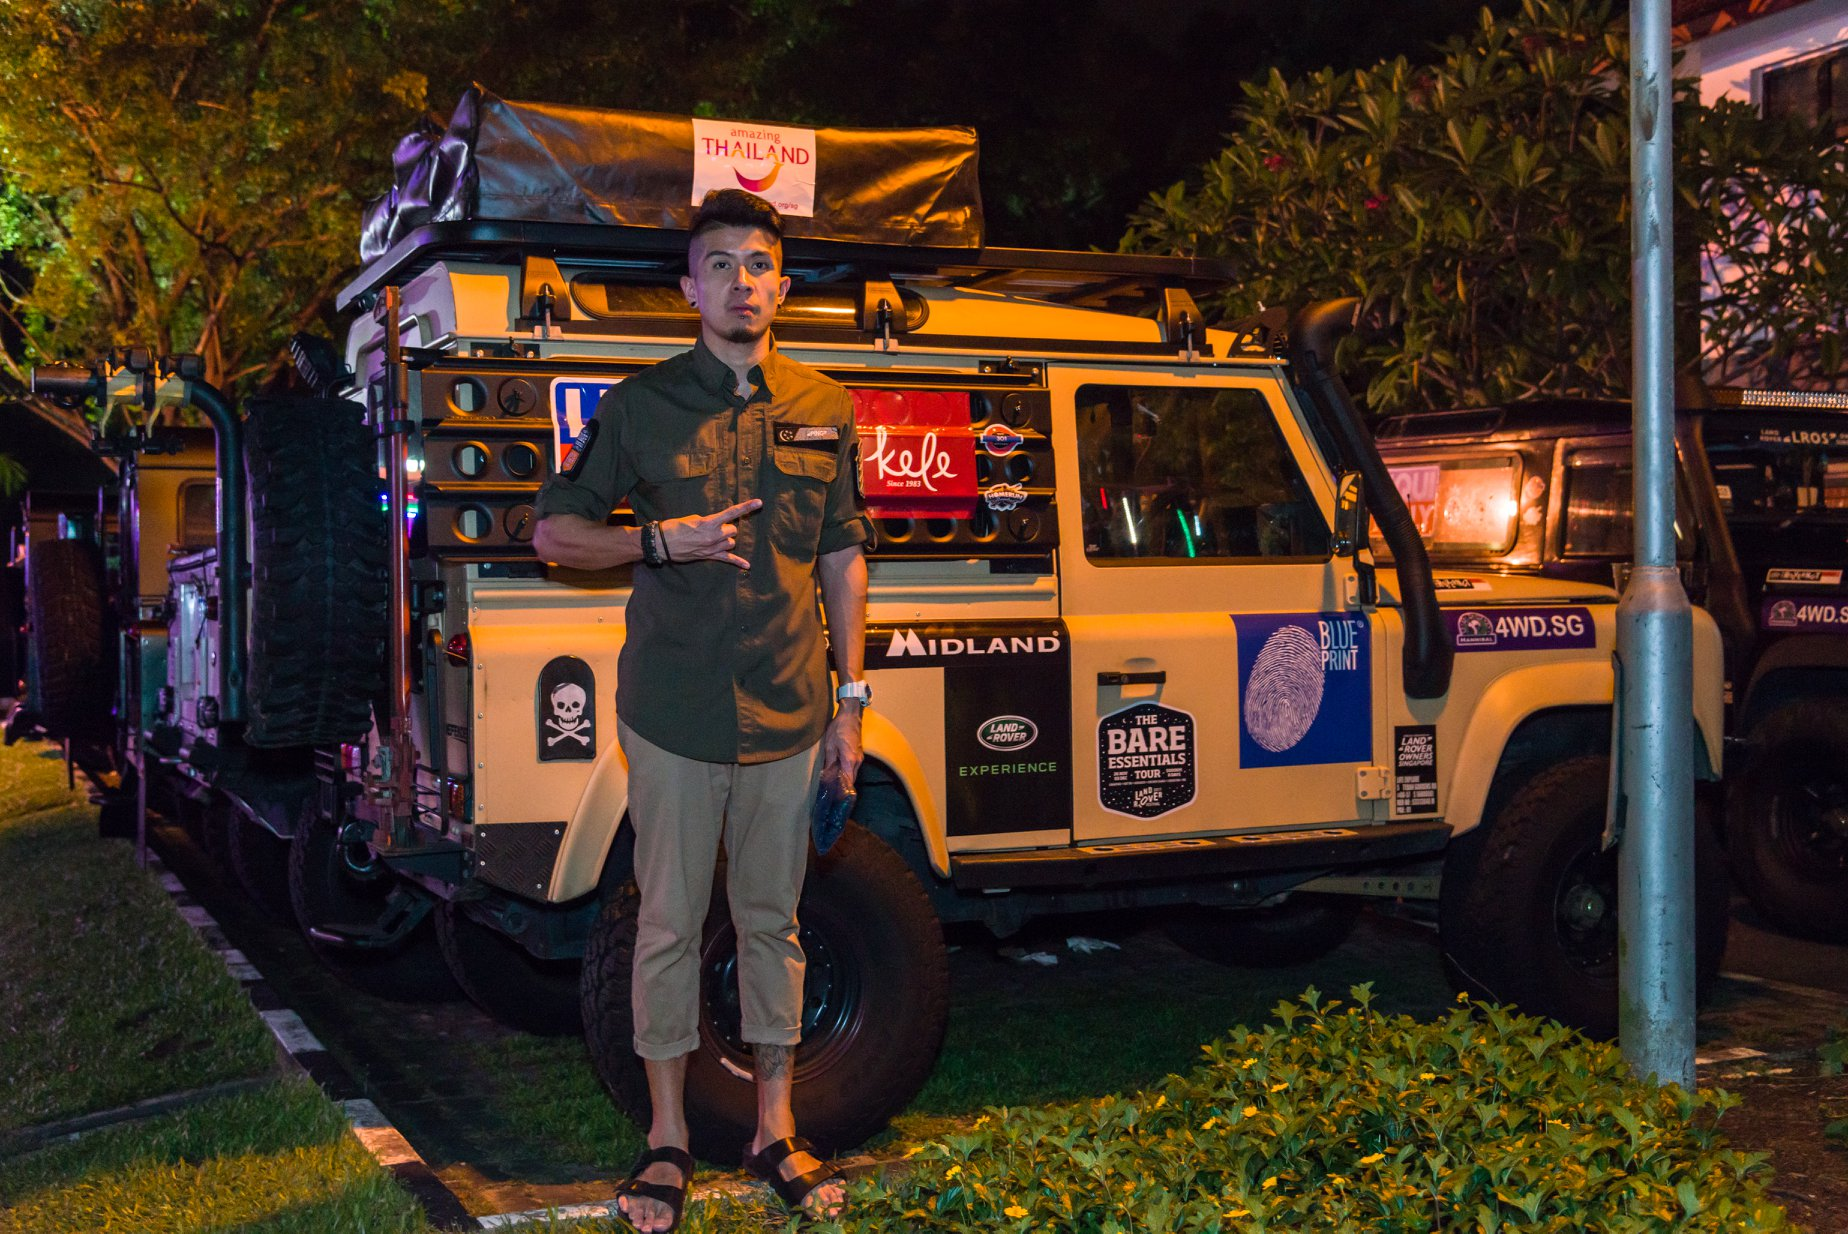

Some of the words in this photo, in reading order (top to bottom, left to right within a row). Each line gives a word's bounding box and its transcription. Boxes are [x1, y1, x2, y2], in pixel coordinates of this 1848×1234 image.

[731, 128, 781, 144] amazing
[702, 137, 809, 165] THAILAND
[1791, 431, 1829, 445] LROS
[864, 425, 958, 492] kele
[886, 480, 905, 488] Since
[906, 480, 922, 488] 1983
[1495, 614, 1584, 638] 4WD.SG
[1318, 620, 1358, 650] BLUE
[886, 628, 1061, 657] MIDLAND
[1321, 650, 1358, 671] PRINT
[1135, 715, 1158, 725] THE
[990, 723, 1018, 733] LAND
[993, 732, 1027, 742] ROVER
[1107, 726, 1186, 755] BARE
[1401, 737, 1427, 745] LAND
[1404, 744, 1433, 752] ROVER
[1108, 753, 1186, 769] ESSENTIALS
[1398, 752, 1433, 760] OWNERS
[959, 762, 1057, 776] EXPERIENCE
[1134, 769, 1161, 779] TOUR
